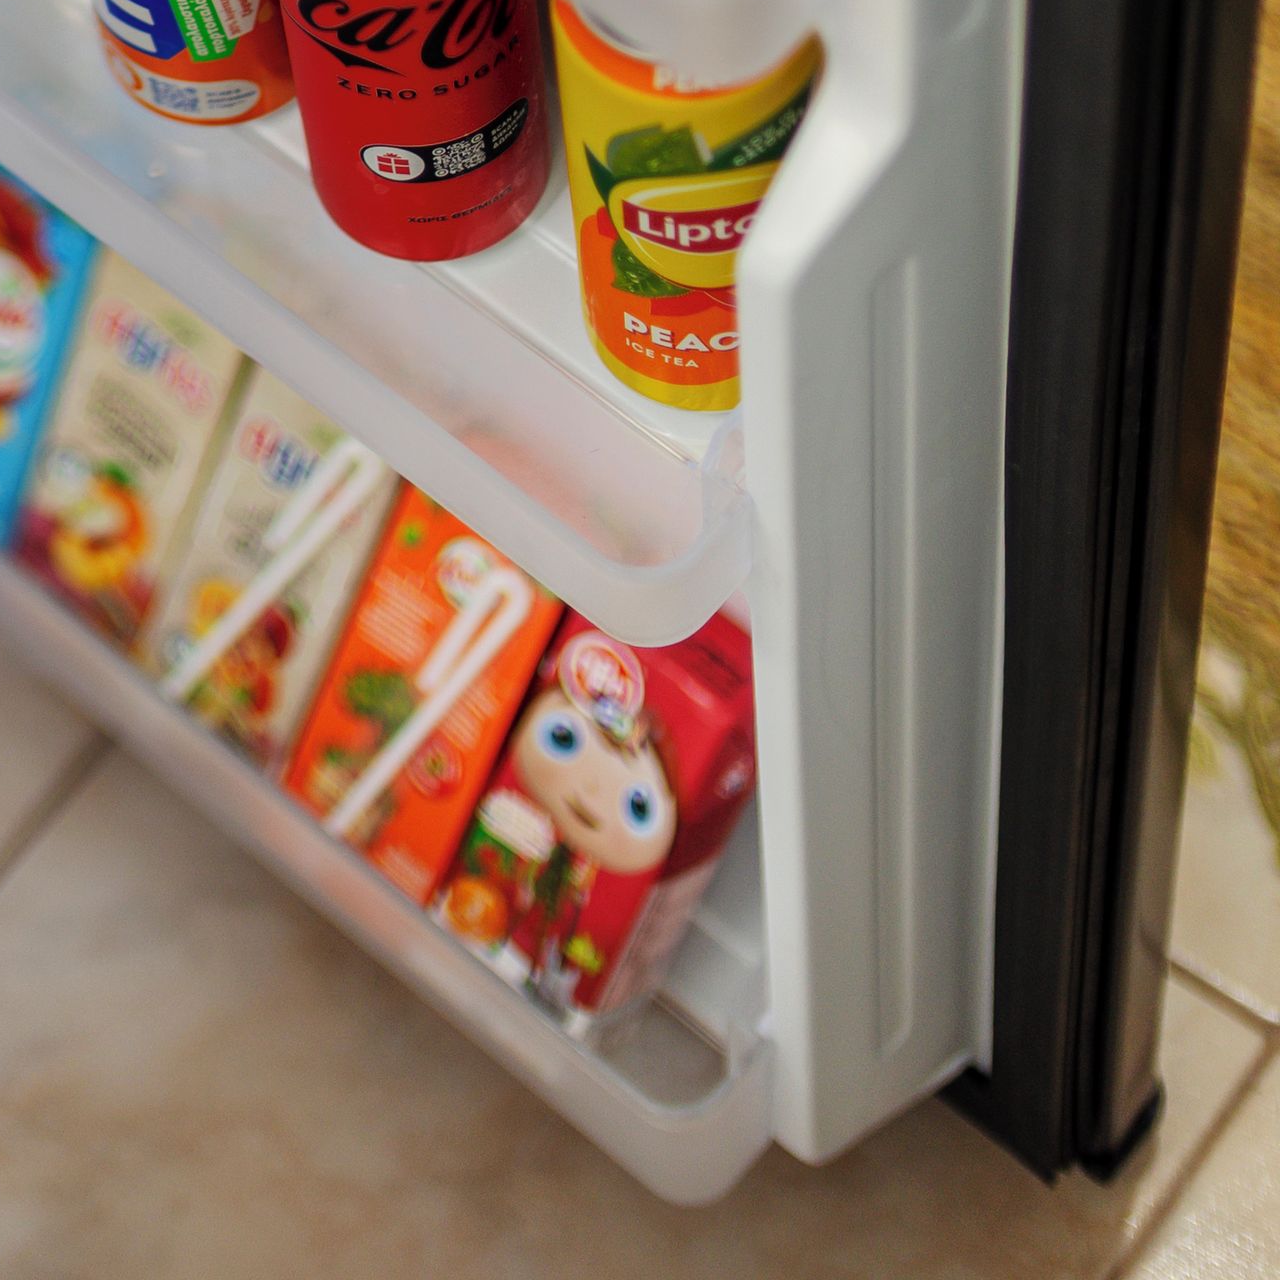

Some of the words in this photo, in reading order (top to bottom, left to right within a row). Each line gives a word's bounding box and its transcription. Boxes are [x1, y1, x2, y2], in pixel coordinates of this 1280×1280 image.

[337, 76, 417, 100] ZERO
[637, 210, 755, 248] Lipto
[623, 311, 740, 352] PEAC
[625, 336, 656, 359] ICE
[660, 353, 700, 368] TEA
